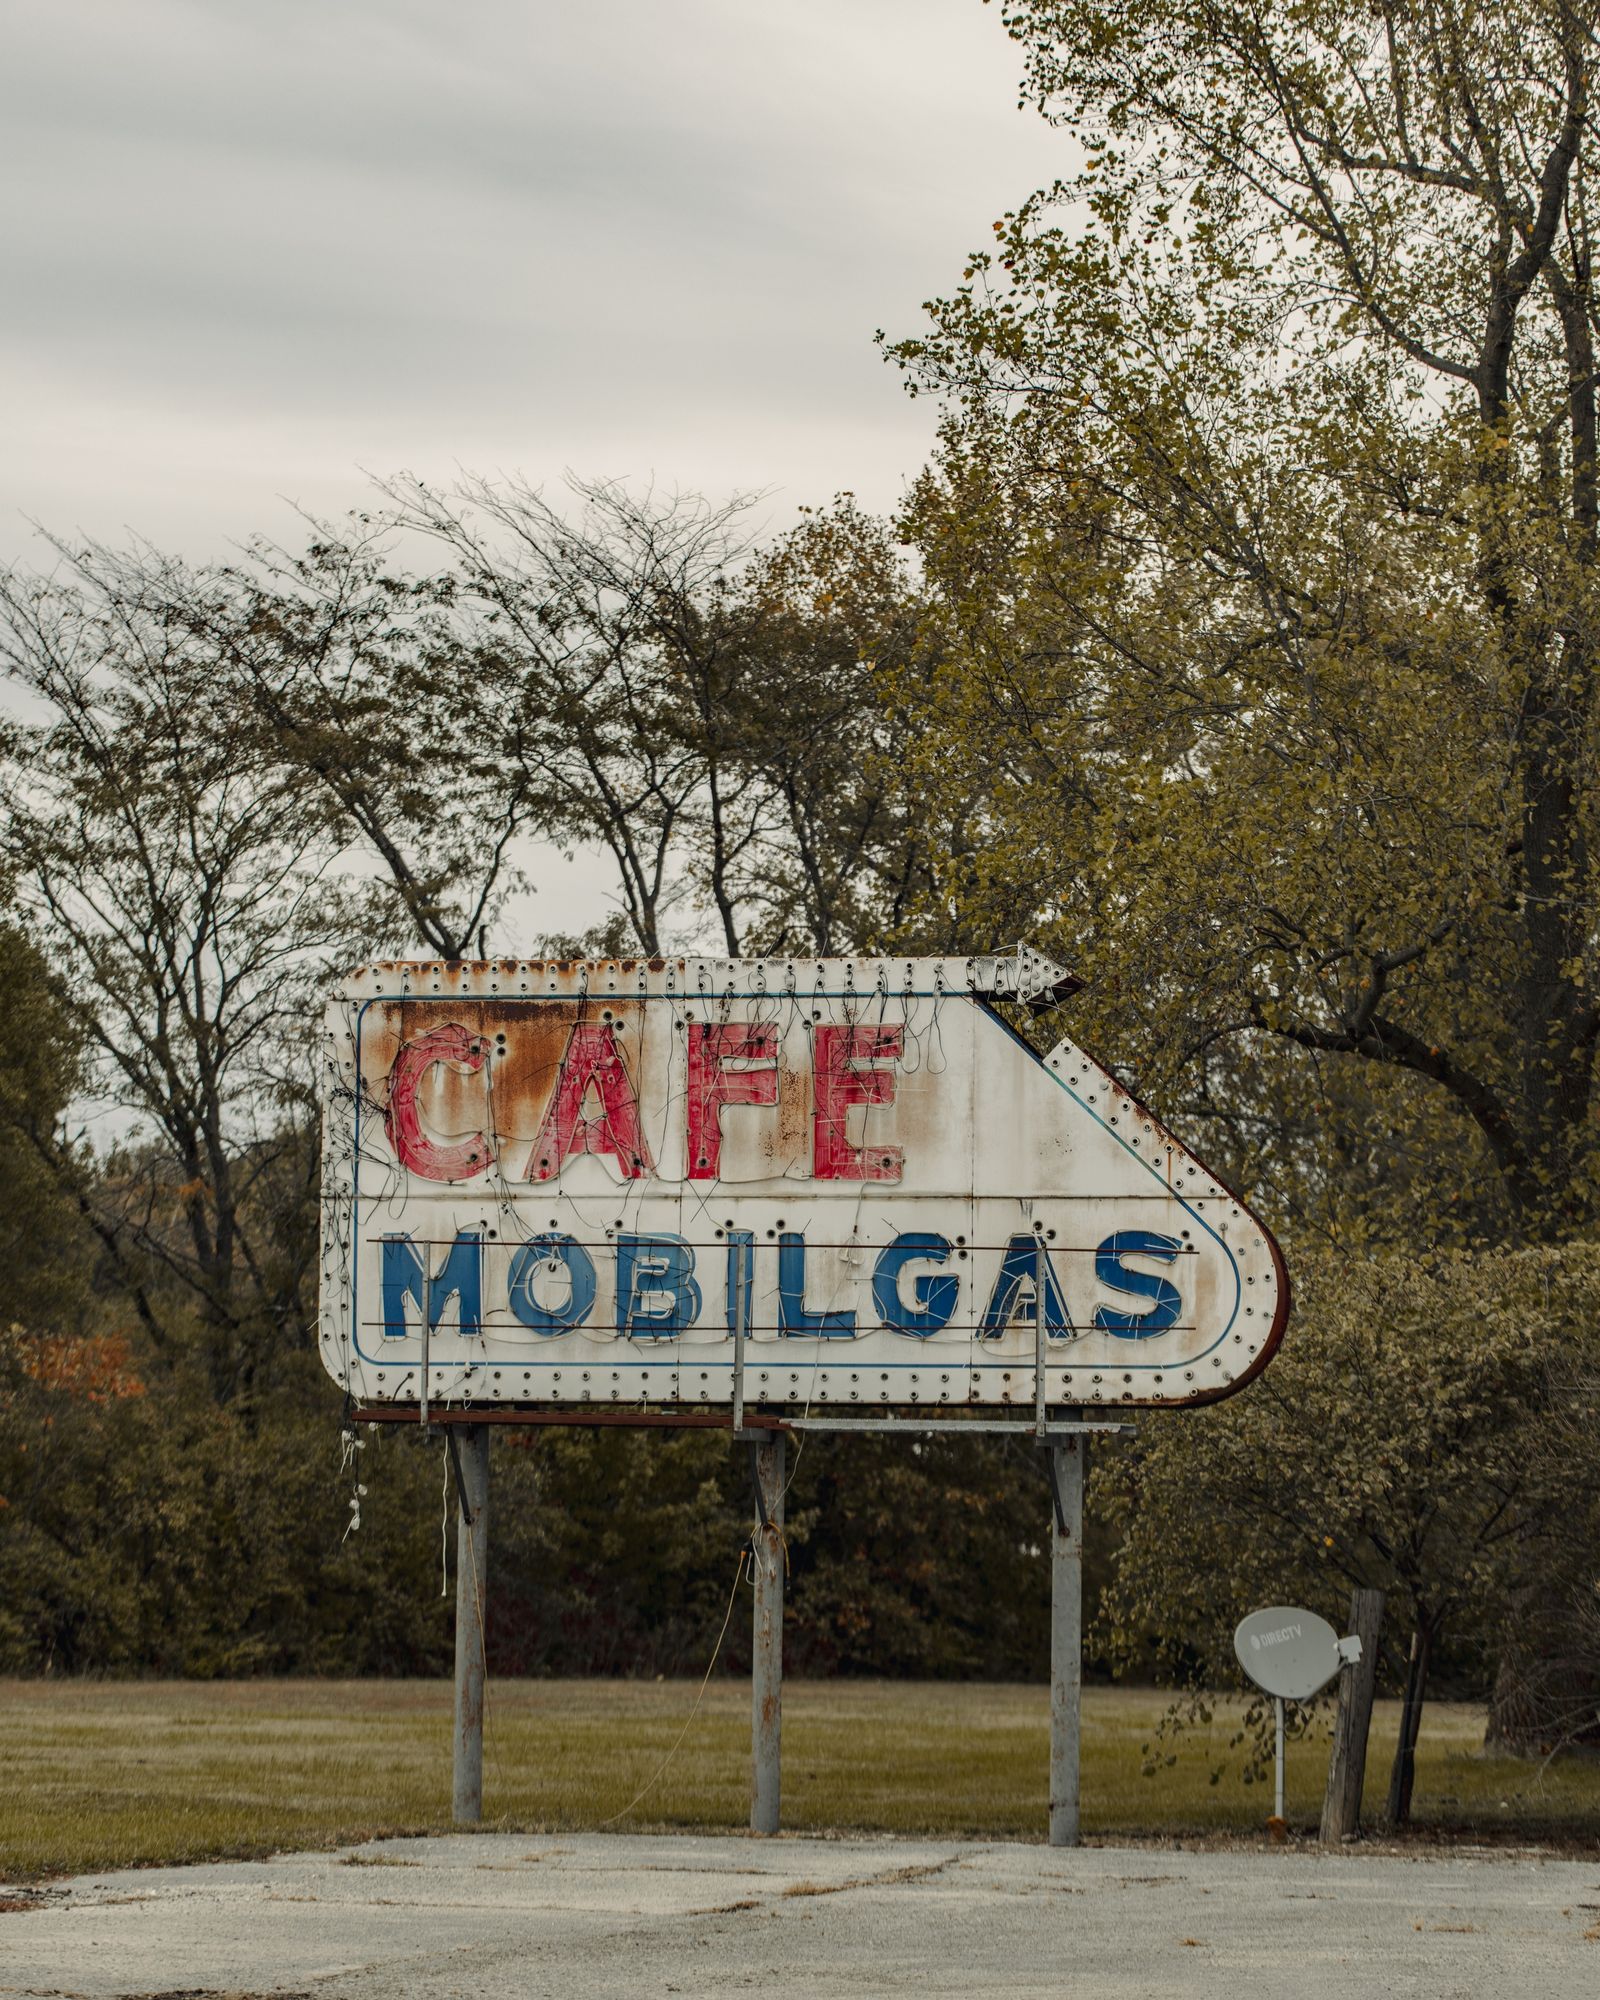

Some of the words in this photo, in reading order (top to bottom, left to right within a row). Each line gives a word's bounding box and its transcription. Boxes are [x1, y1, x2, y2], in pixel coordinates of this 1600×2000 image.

[386, 1022, 904, 1182] CAFE
[382, 1230, 1184, 1341] MOBILGAS
[1260, 1624, 1302, 1647] DIRECTV
